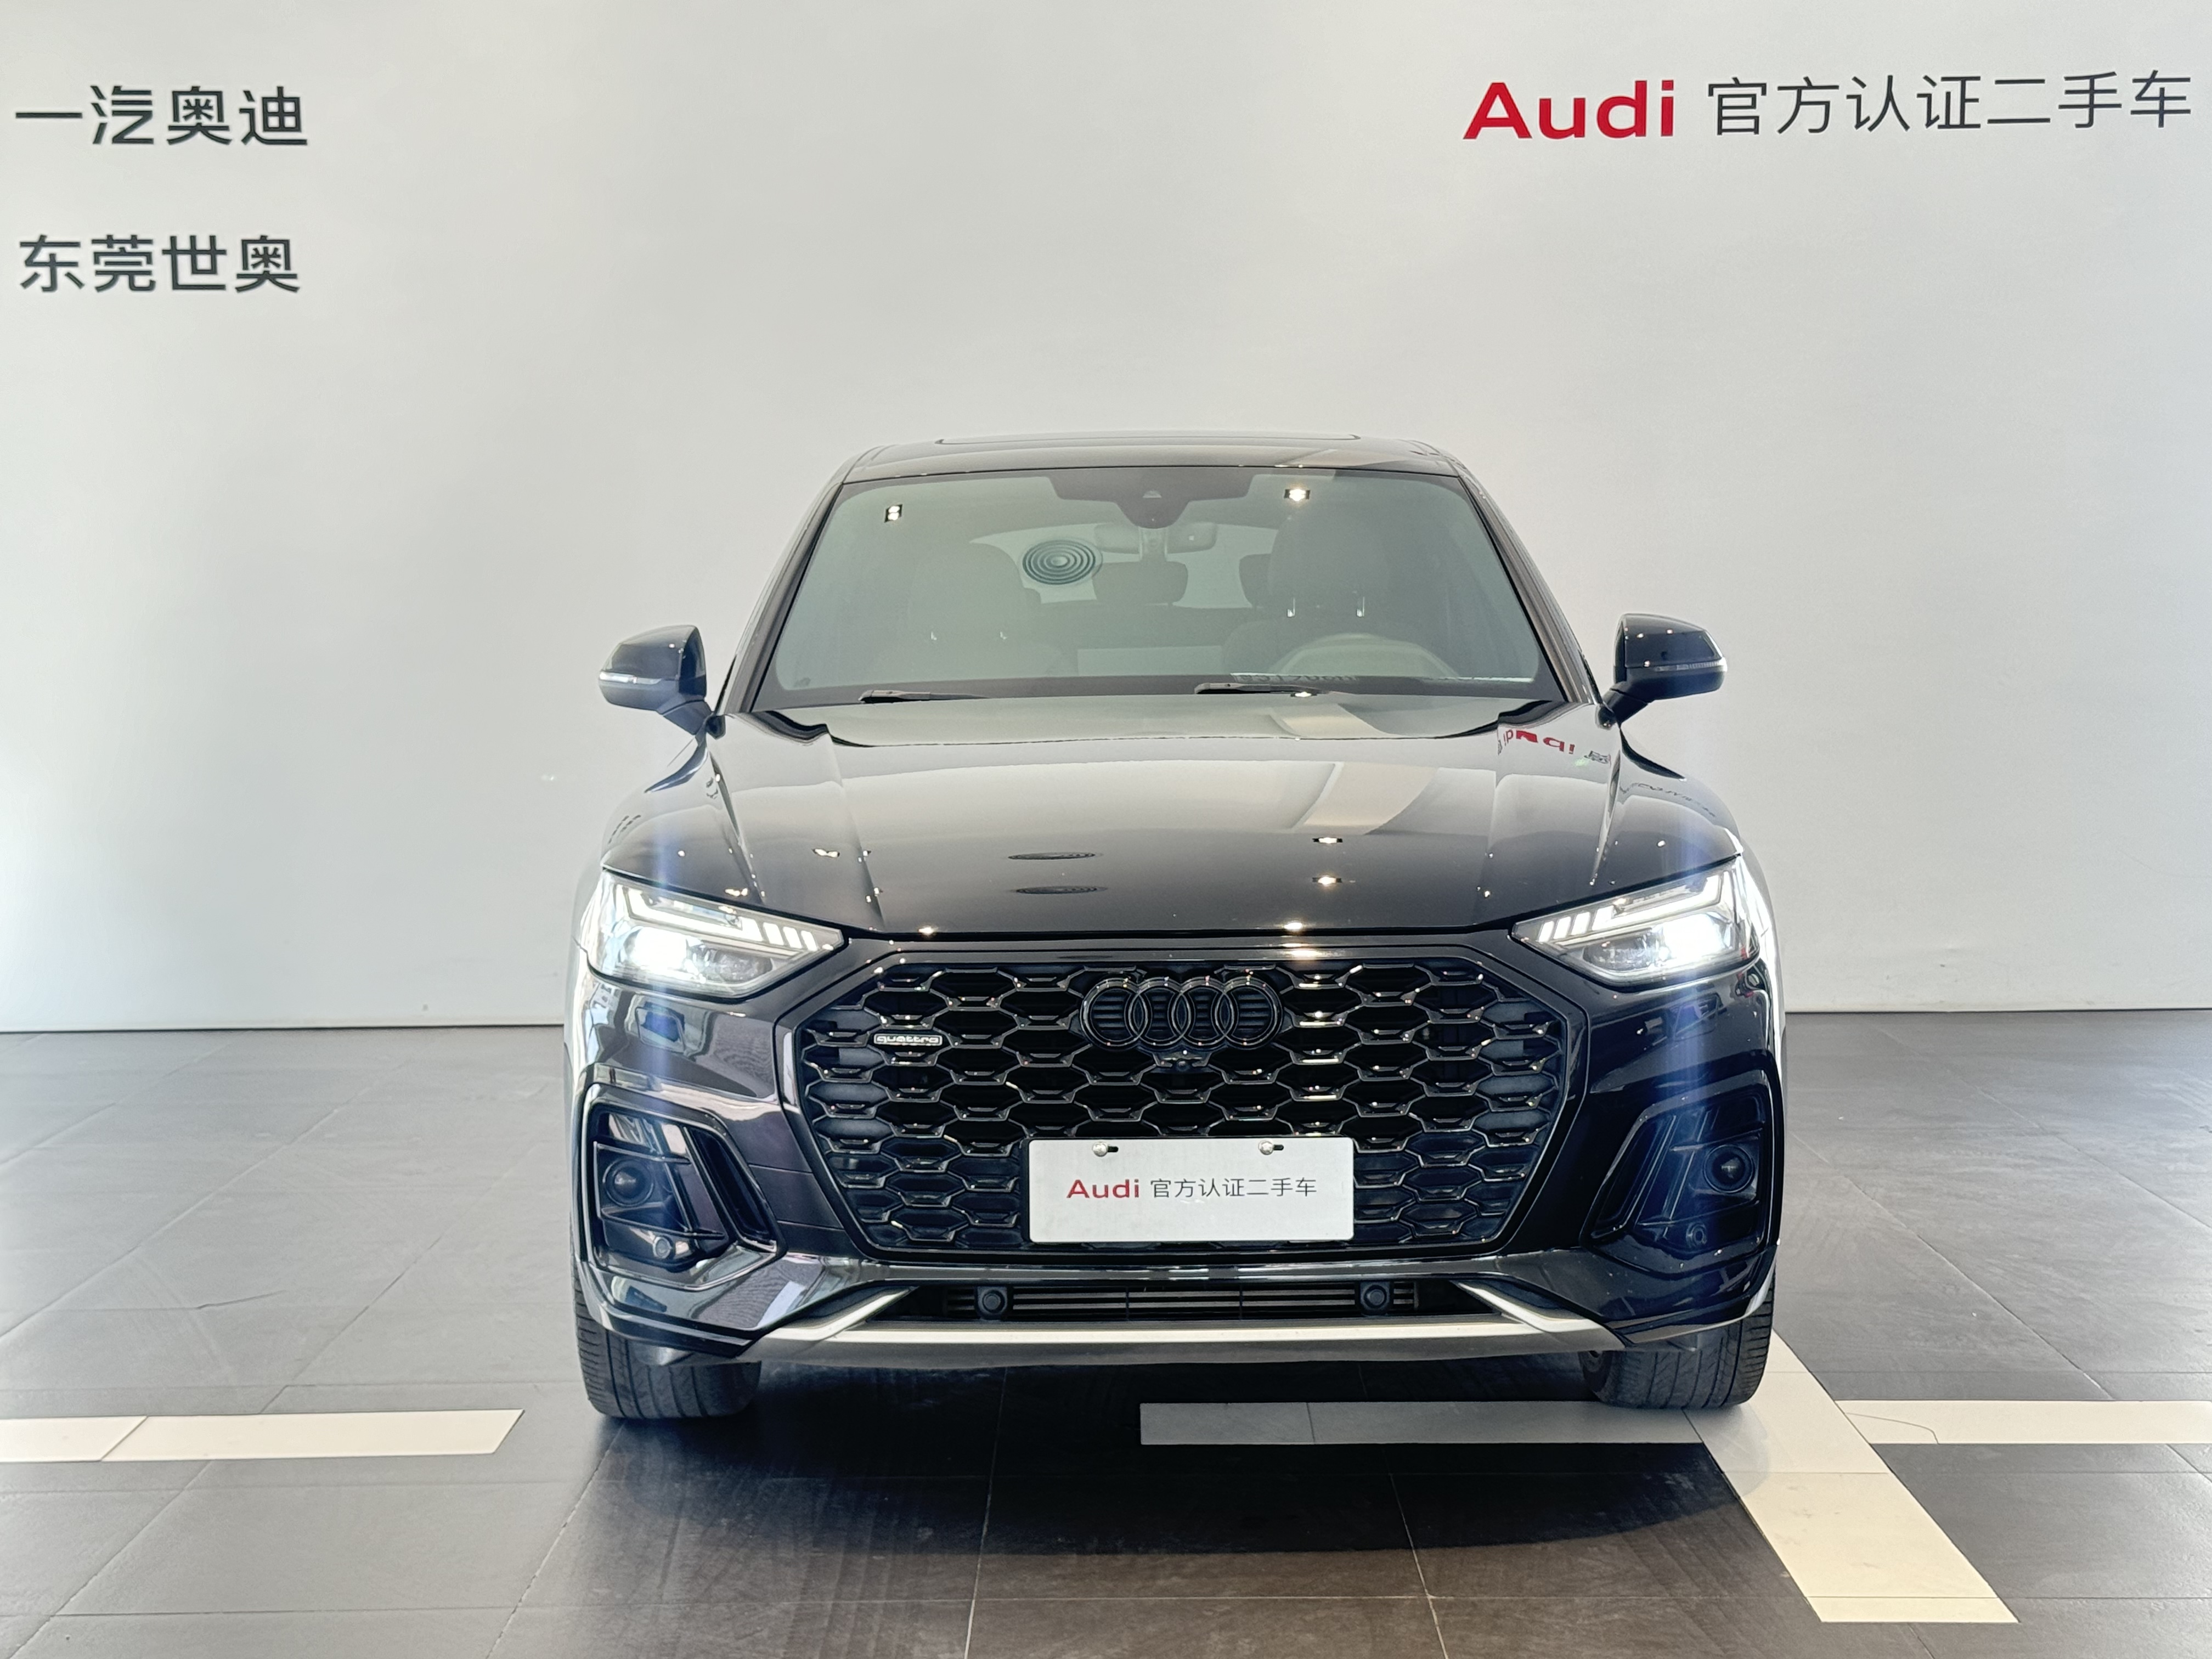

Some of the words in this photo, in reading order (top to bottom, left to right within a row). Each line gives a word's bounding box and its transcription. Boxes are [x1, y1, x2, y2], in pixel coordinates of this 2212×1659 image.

[15, 84, 308, 146] 一汽奥迪
[1463, 80, 1675, 140] Audi
[1707, 69, 2192, 136] 官方认证二手车
[19, 234, 301, 293] 东莞世奥
[877, 1035, 939, 1044] quattro
[1066, 1179, 1139, 1199] Audi
[1150, 1177, 1317, 1198] 官方认证二手车
